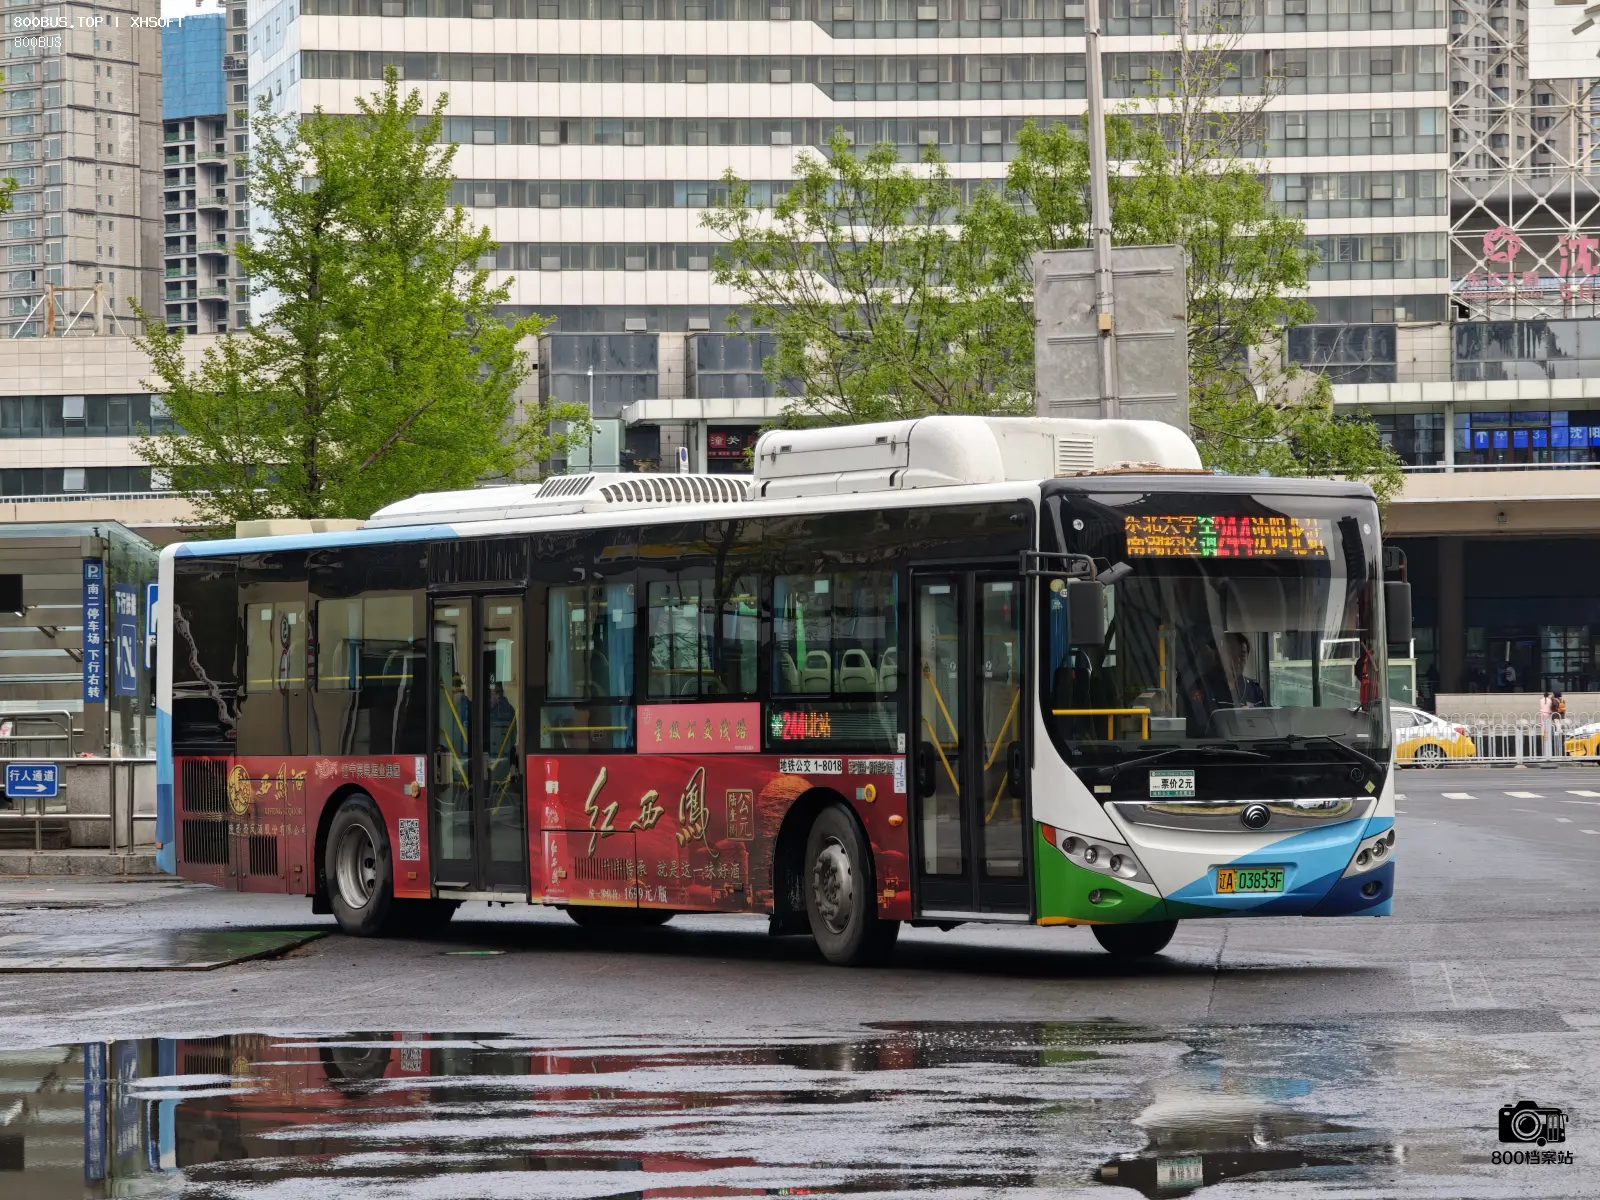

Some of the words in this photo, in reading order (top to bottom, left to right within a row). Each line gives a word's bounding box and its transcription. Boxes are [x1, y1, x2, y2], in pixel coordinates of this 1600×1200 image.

[87, 583, 100, 645] 南二停车场
[87, 649, 100, 698] 下行右转
[780, 759, 811, 773] 地铁公交
[814, 759, 842, 773] 1-8018
[9, 769, 55, 782] 行人通道
[1161, 778, 1193, 790] 票价2元
[1219, 873, 1233, 889] 辽A
[1238, 872, 1283, 889] 03853F
